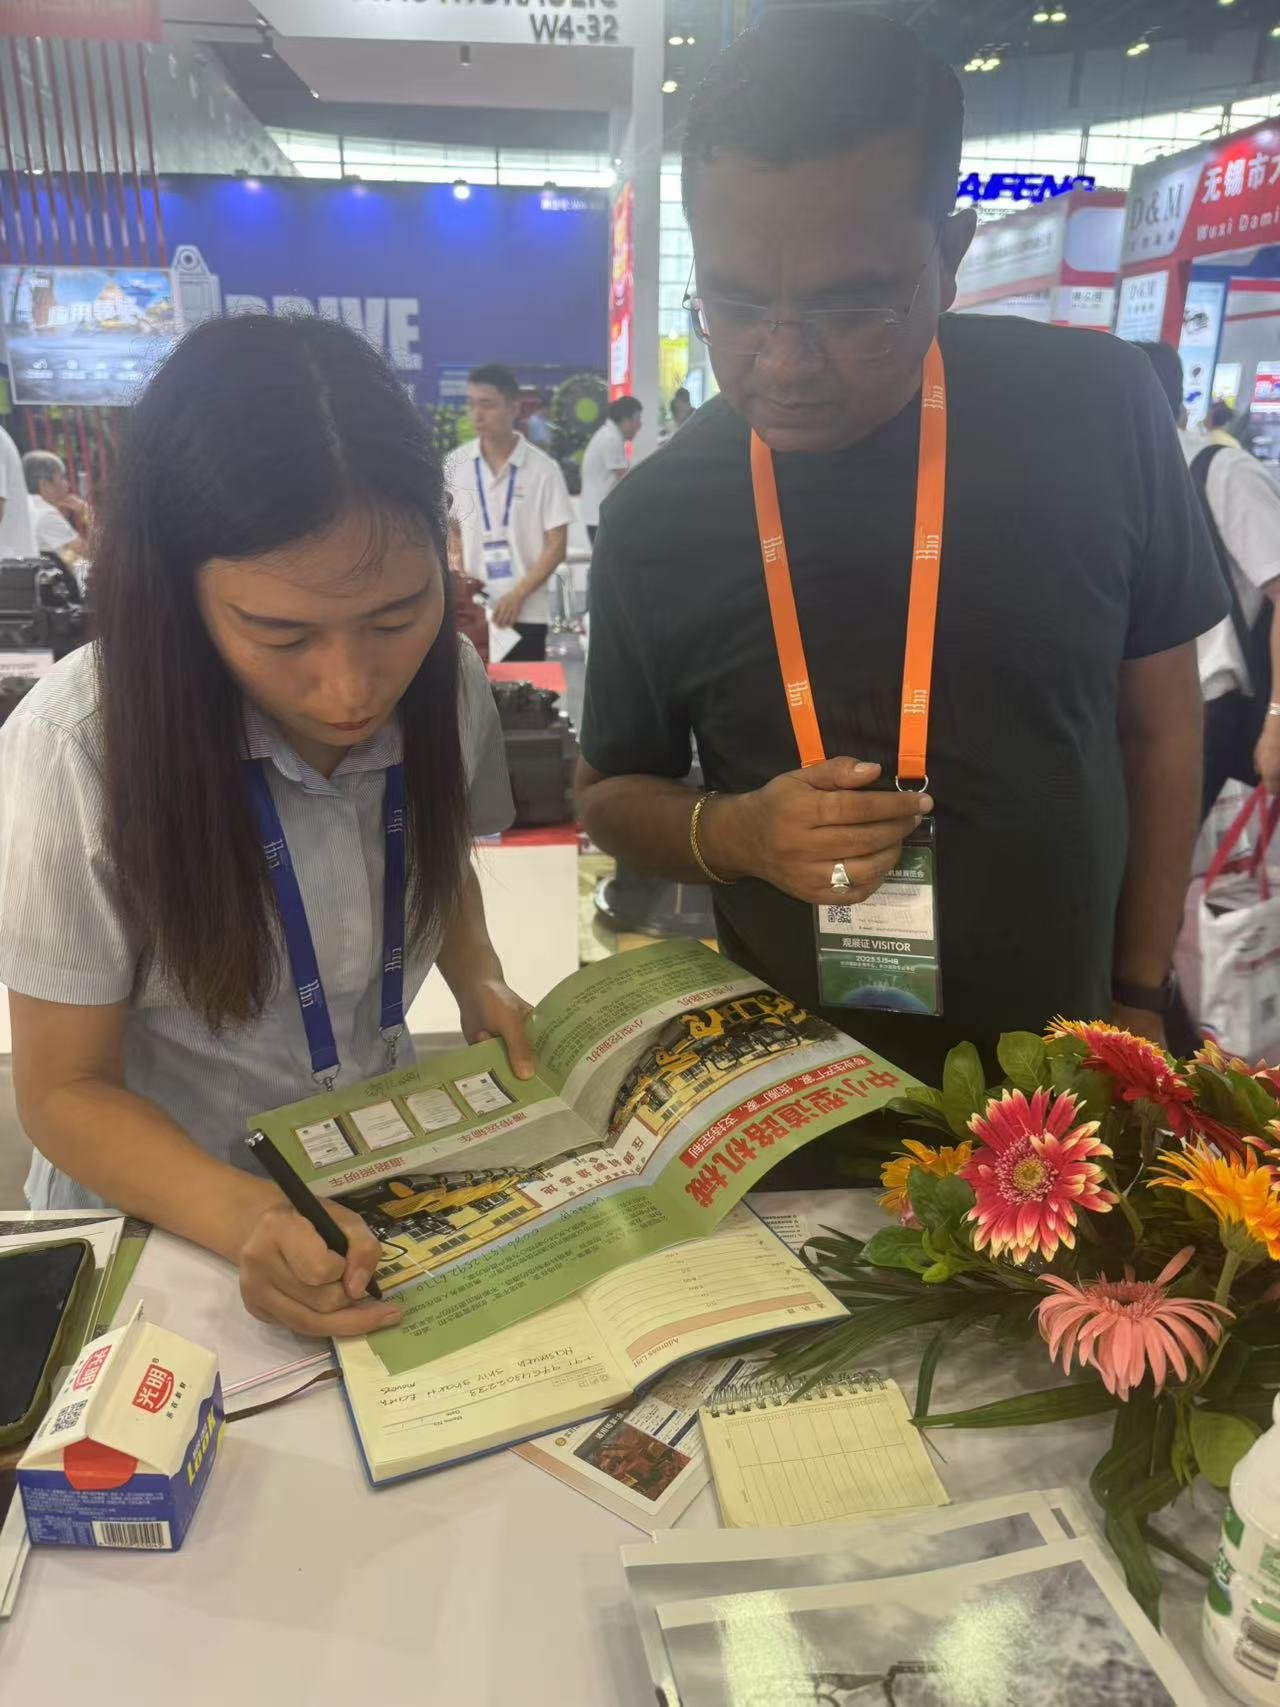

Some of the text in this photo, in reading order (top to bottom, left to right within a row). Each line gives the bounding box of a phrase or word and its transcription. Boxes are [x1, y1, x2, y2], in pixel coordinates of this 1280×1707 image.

[530, 14, 619, 43] W4-32
[1131, 183, 1185, 230] D&M
[1196, 217, 1233, 242] Wuxi
[842, 938, 911, 952] 观展证 VISITOR
[685, 1068, 900, 1209] 中小型道路机械
[328, 1156, 406, 1188] 道路照明车
[649, 1337, 680, 1357] Address
[80, 1346, 110, 1389] 光明
[136, 1366, 169, 1410] 光明
